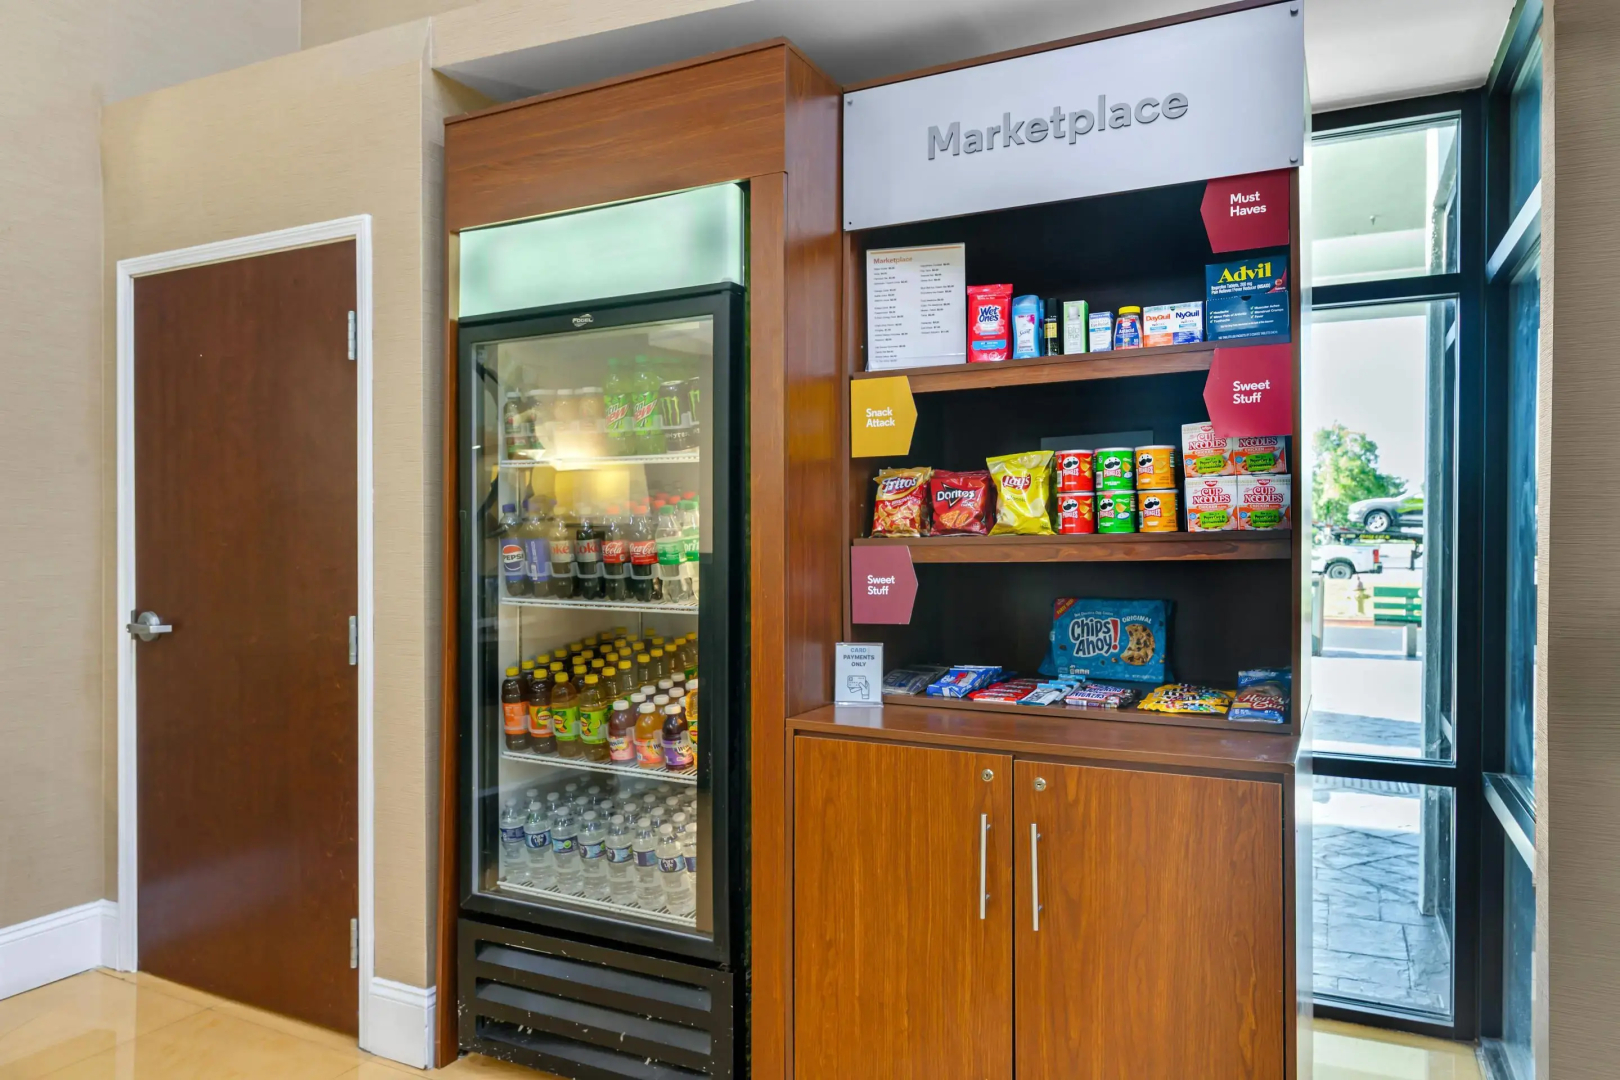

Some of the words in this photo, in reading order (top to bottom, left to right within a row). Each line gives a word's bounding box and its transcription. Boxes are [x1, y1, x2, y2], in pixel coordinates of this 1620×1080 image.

[927, 92, 1189, 161] Marketplace
[1230, 191, 1261, 205] Must
[1230, 204, 1267, 217] Haves
[873, 256, 913, 265] Marketplace
[1217, 262, 1272, 284] Advil
[980, 306, 999, 315] Wet
[1175, 310, 1200, 319] NyQuil
[979, 313, 999, 322] Ones
[1145, 313, 1171, 322] DayQuil
[1232, 380, 1270, 392] Sweet
[1232, 392, 1261, 404] Stuff
[865, 407, 893, 418] Snack
[865, 418, 895, 428] Attack
[1188, 439, 1227, 450] NOODLES
[1239, 437, 1278, 448] NOODLES
[881, 477, 917, 493] Fritos
[1002, 475, 1031, 490] Lay's
[937, 490, 976, 501] Doritos
[1200, 488, 1223, 496] CUP
[1252, 486, 1276, 495] CUP
[1192, 495, 1231, 505] NOODLES
[1243, 494, 1284, 503] NOODLES
[503, 553, 524, 561] PEPSI
[867, 574, 895, 585] Sweet
[867, 585, 889, 595] Stuff
[1121, 615, 1152, 625] ORIGINAL
[1069, 617, 1112, 643] Chips
[1242, 694, 1285, 704] Honey
[1252, 701, 1285, 712] Bun
